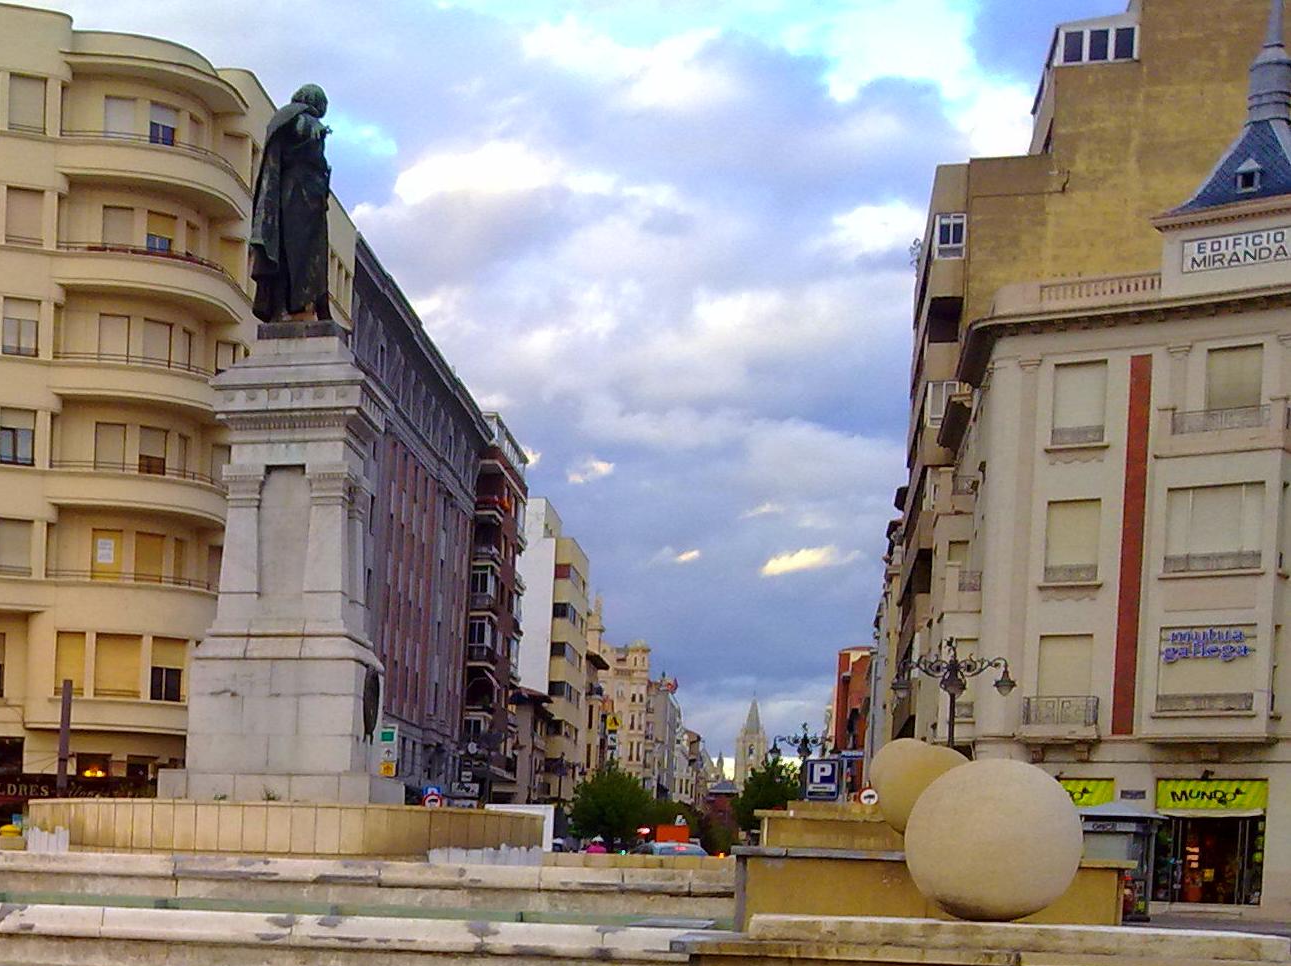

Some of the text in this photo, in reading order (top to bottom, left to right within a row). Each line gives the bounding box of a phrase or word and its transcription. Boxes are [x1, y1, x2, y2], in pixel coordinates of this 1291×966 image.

[1196, 230, 1286, 255] EDIFICIO
[1190, 244, 1289, 270] MIRANDA
[1170, 628, 1244, 643] mutua
[1162, 640, 1250, 664] gallega
[813, 763, 832, 783] P
[1170, 788, 1237, 804] MUNDO
